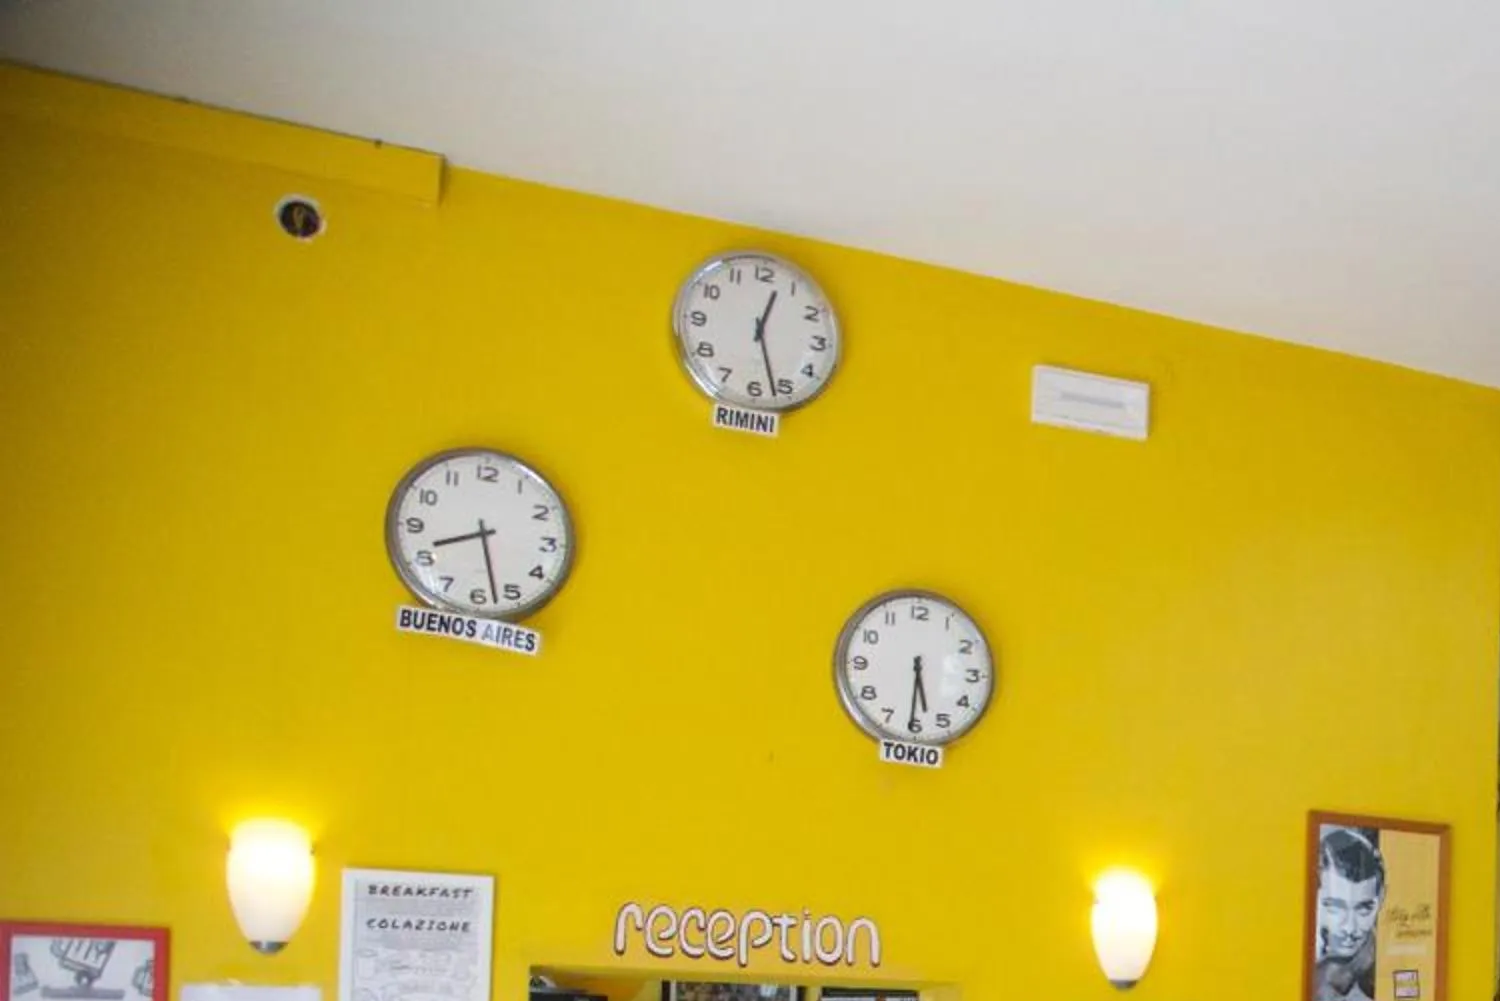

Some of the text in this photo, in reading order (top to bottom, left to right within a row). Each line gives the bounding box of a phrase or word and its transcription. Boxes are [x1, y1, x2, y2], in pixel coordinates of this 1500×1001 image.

[730, 268, 741, 285] 11
[755, 266, 774, 283] 12
[704, 284, 720, 300] 10
[691, 310, 707, 327] 9
[804, 305, 819, 322] 2
[697, 341, 714, 358] 8
[810, 335, 826, 352] 3
[718, 367, 732, 383] 7
[802, 364, 814, 378] 4
[747, 381, 762, 397] 6
[777, 379, 793, 395] 5
[715, 407, 775, 433] RIMINI
[446, 471, 459, 487] 11
[476, 465, 498, 483] 12
[419, 489, 438, 506] 10
[532, 505, 550, 521] 2
[406, 517, 425, 533] 9
[539, 537, 557, 553] 3
[528, 565, 544, 580] 4
[440, 577, 454, 593] 7
[504, 584, 521, 600] 5
[470, 589, 487, 604] 6
[885, 611, 896, 626] 11
[911, 605, 929, 621] 12
[400, 609, 536, 651] BUENOS AIRES
[863, 629, 879, 645] 10
[959, 639, 973, 654] 2
[853, 656, 868, 671] 9
[965, 669, 980, 683] 3
[861, 685, 877, 701] 8
[956, 695, 970, 708] 4
[881, 708, 894, 723] 7
[936, 714, 951, 728] 5
[883, 742, 939, 765] TOKIO
[368, 884, 474, 899] BREAKFAST
[366, 918, 472, 933] COLAZIONE
[614, 901, 881, 967] reception
